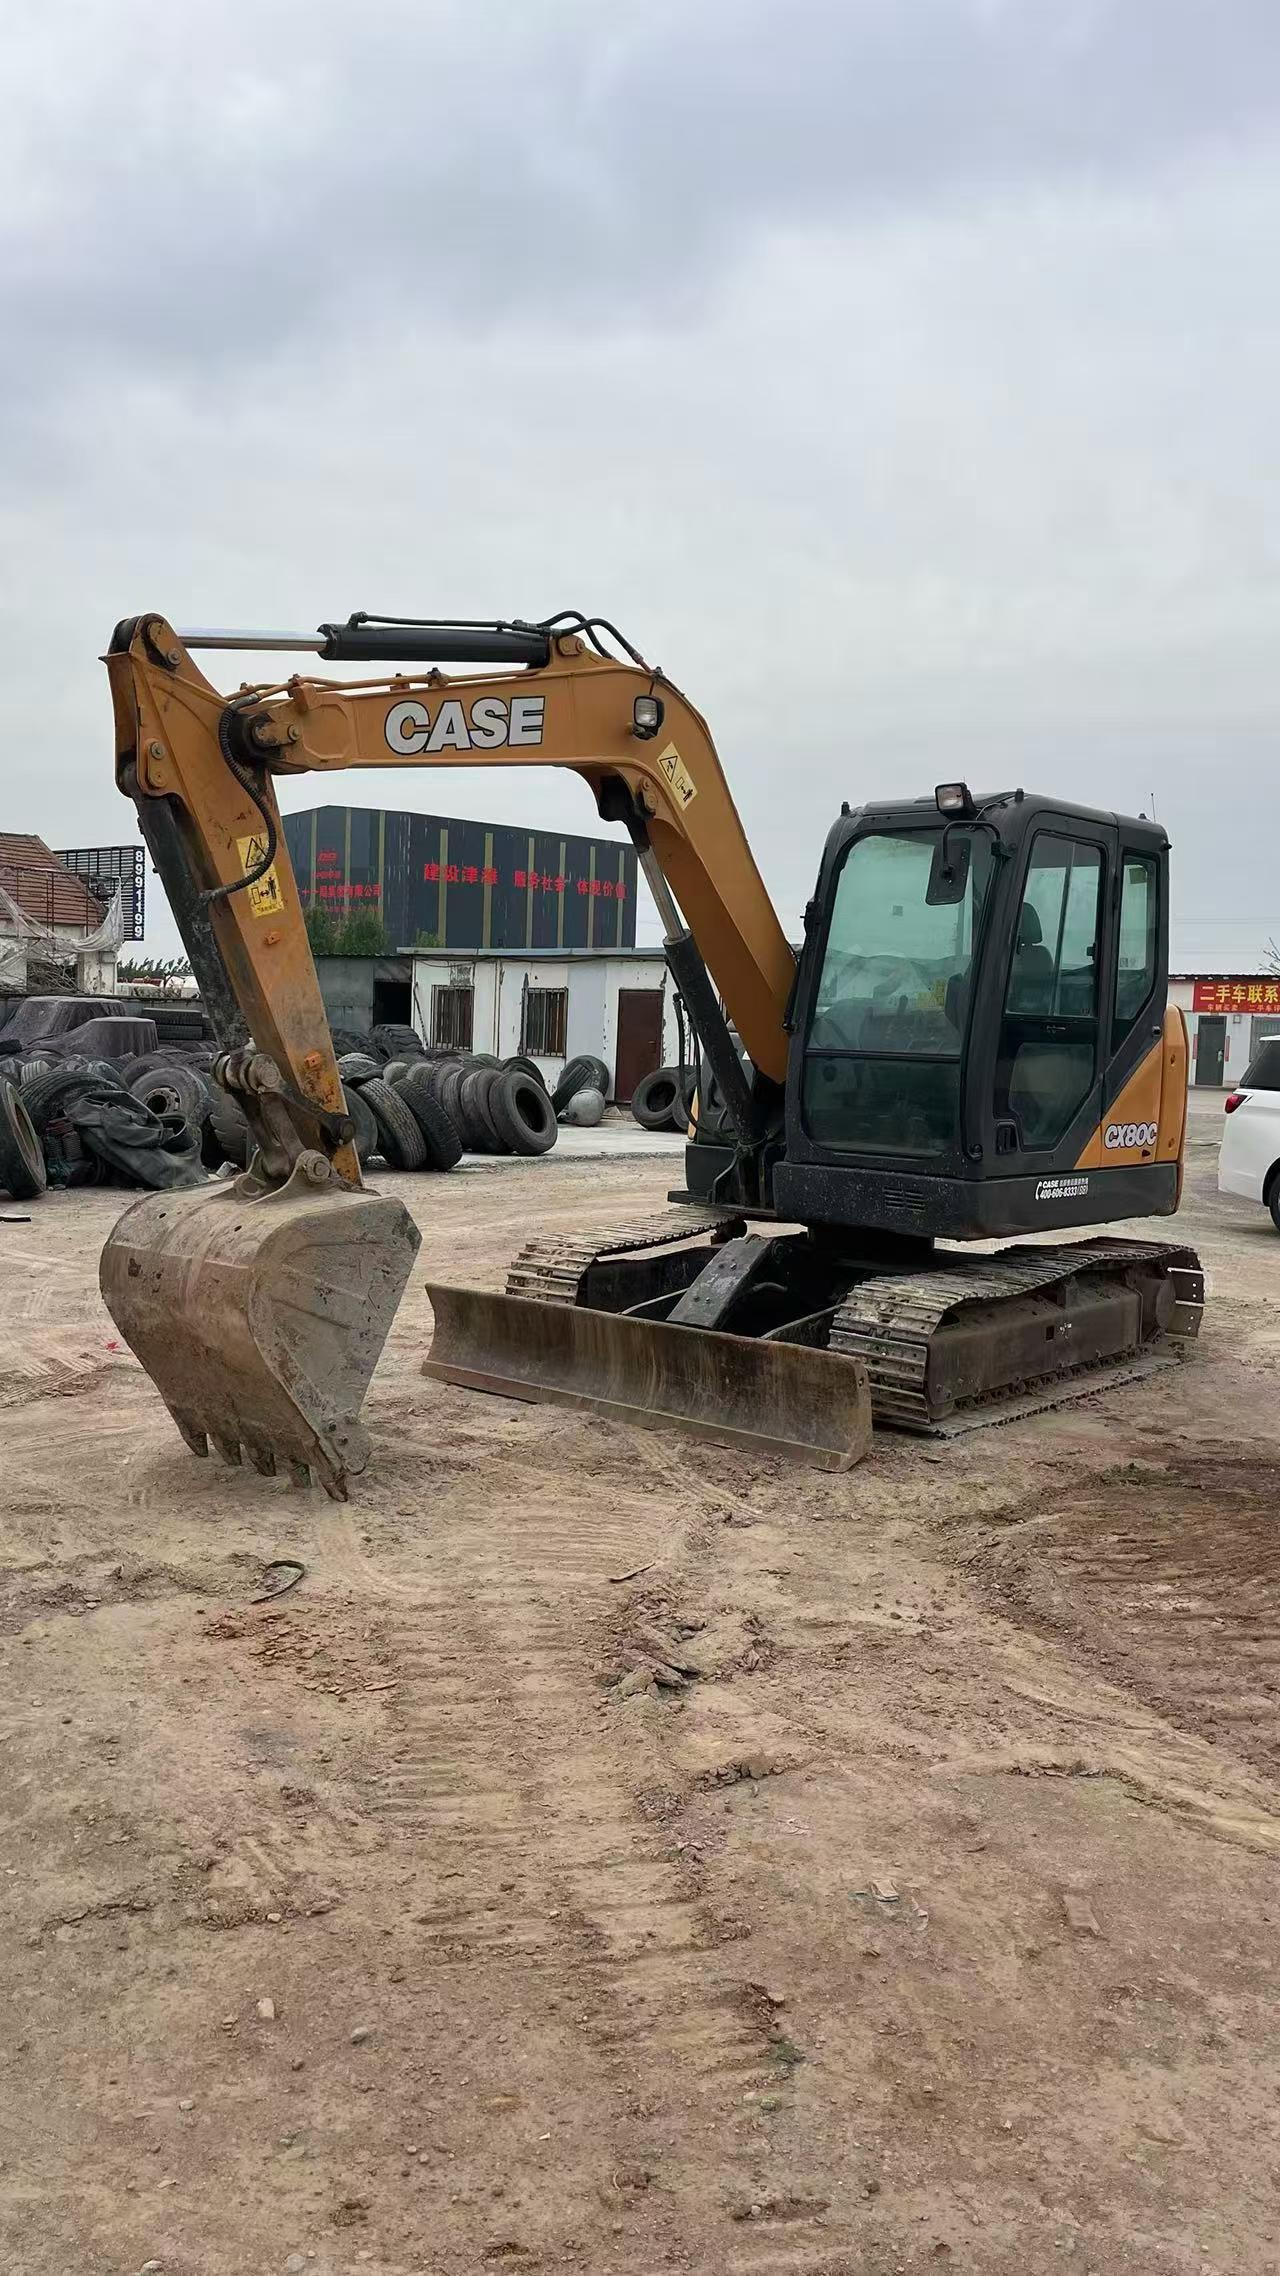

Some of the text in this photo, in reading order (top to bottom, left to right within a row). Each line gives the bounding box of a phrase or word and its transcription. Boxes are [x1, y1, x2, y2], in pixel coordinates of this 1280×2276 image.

[384, 696, 546, 755] CASE
[134, 850, 144, 938] 8991199
[1200, 984, 1279, 1004] 二手车联系
[1104, 1122, 1158, 1149] CX80C
[1042, 1180, 1060, 1189] CASE
